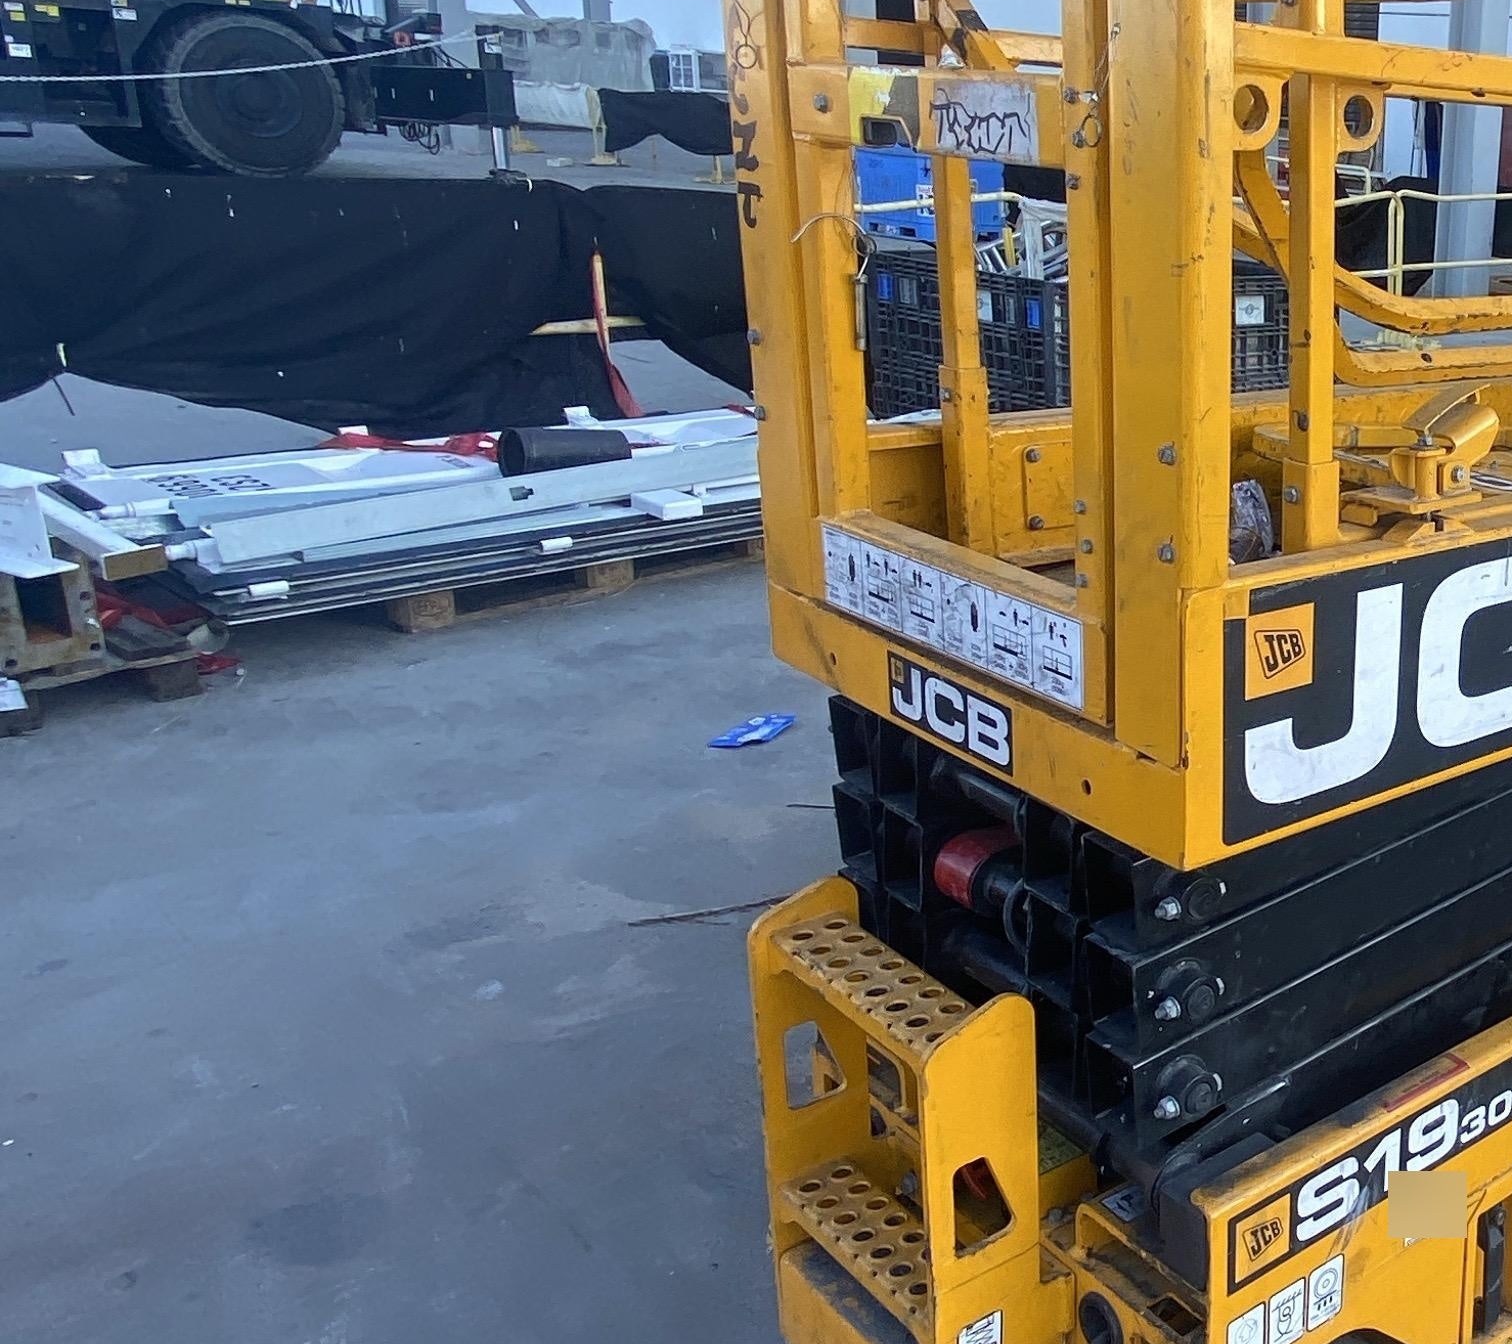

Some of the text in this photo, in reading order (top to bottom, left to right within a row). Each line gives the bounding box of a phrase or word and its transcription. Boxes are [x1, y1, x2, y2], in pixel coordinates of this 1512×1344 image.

[1260, 630, 1304, 673] JCB
[892, 667, 1010, 766] JCB
[1249, 1217, 1282, 1259] JCB
